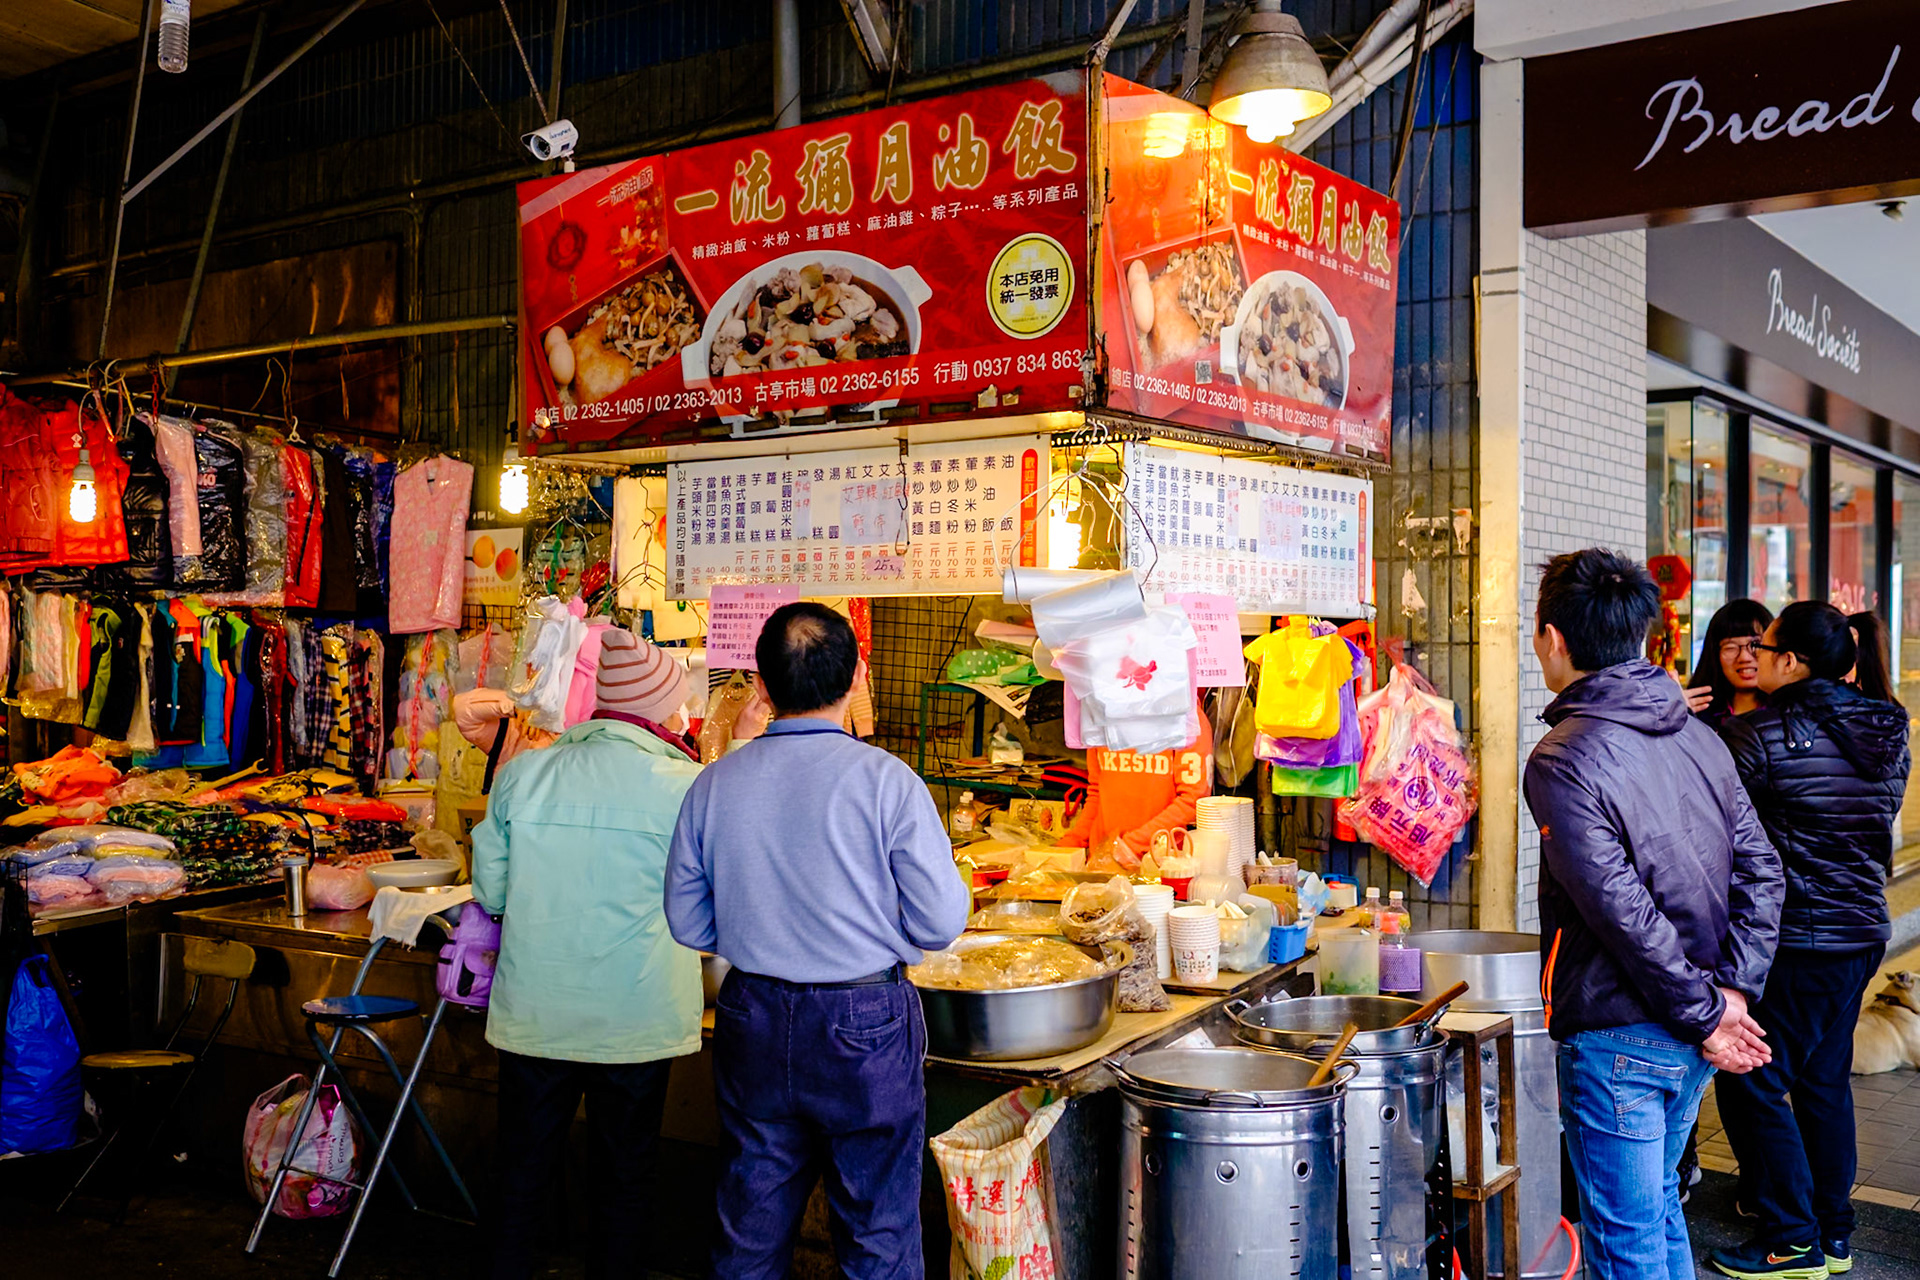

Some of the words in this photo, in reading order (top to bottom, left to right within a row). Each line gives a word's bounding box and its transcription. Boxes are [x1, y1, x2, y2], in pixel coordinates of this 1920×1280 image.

[1634, 44, 1901, 172] Bread
[1000, 268, 1059, 288] 本店免用
[1000, 284, 1059, 305] 統一發票
[1766, 268, 1817, 346] Bread
[564, 406, 578, 421] 02
[581, 396, 644, 420] 2362-1405
[647, 397, 651, 413] /
[655, 398, 670, 415] 02
[674, 387, 742, 409] 2363-2013
[754, 377, 815, 403] 古亭市場
[820, 376, 837, 394] 02
[842, 367, 919, 392] 2362-6155
[933, 361, 968, 384] 行動
[973, 357, 1011, 379] 0937
[1017, 353, 1046, 374] 834
[1112, 367, 1131, 389] 總店
[1133, 373, 1144, 390] 02
[1146, 376, 1190, 402] 2362-1405
[1196, 388, 1207, 405] 02
[1208, 390, 1247, 413] 2363-2013
[1252, 400, 1283, 423] 古亭市場
[1284, 408, 1293, 424] 02
[1294, 410, 1328, 430] 2362-6155
[691, 477, 702, 546] 芋頭米粉湯
[705, 477, 717, 545] 當歸四神湯
[735, 474, 746, 543] 港式蘿蔔糕
[750, 473, 762, 543] 芋頭糕
[765, 472, 777, 542] 蘿蔔糕
[912, 461, 925, 536] 素炒黃麵
[929, 460, 942, 535] 葷炒白麵
[947, 458, 959, 534] 素炒冬粉
[964, 457, 978, 533] 葷炒米粉
[982, 456, 996, 532] 素油飯
[1000, 454, 1015, 531] 油飯
